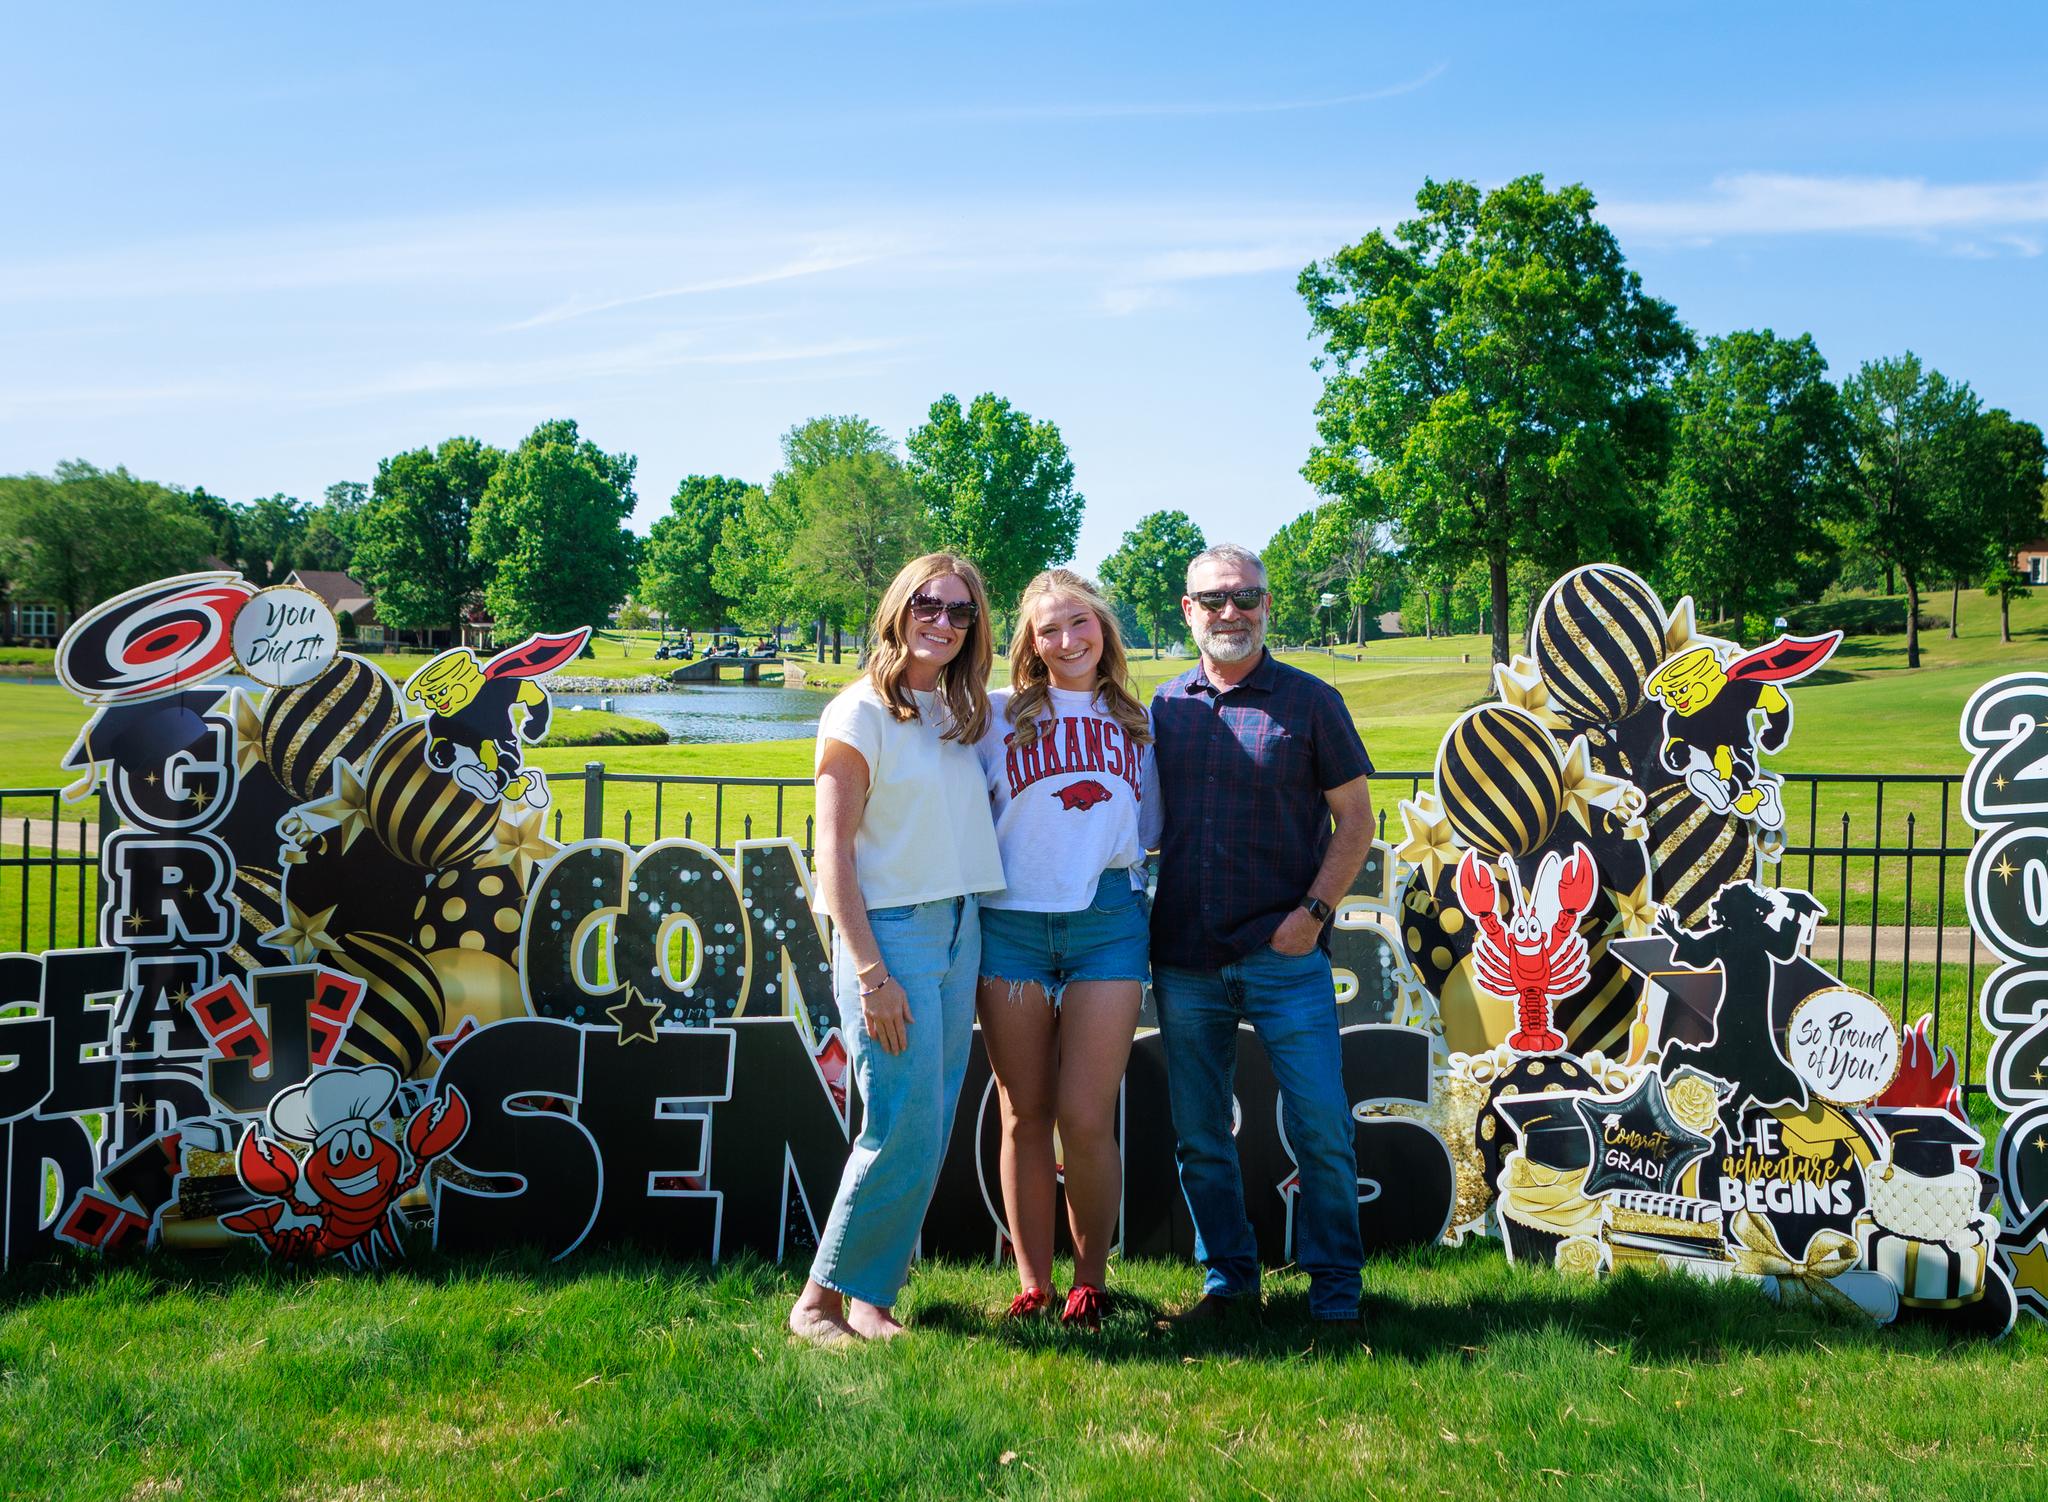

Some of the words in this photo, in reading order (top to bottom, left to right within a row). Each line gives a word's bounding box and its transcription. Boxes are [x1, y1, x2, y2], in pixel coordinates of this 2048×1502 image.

[266, 602, 316, 638] You
[246, 638, 293, 667] Did
[208, 969, 318, 1114] J
[1796, 1018, 1823, 1046] So
[1826, 1011, 1889, 1053] Proud
[1807, 1045, 1828, 1079] of
[1826, 1046, 1888, 1091] You!
[1605, 1149, 1664, 1181] GRAD!
[1722, 1145, 1841, 1190] adventure
[1718, 1176, 1853, 1216] BEGINS
